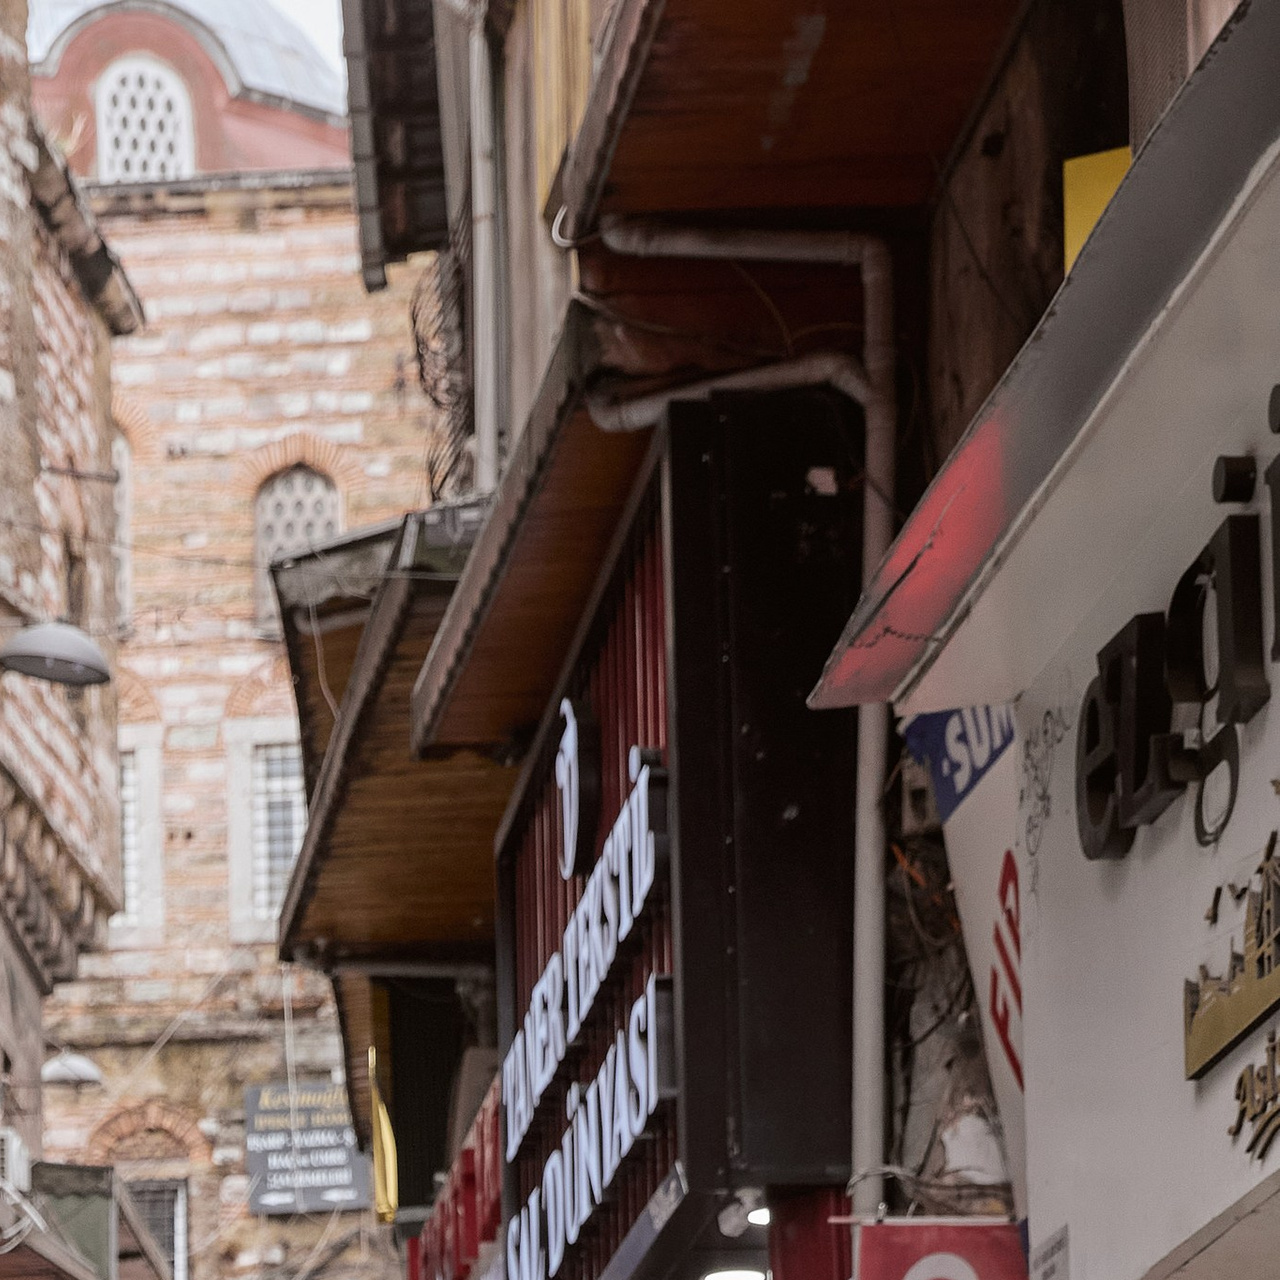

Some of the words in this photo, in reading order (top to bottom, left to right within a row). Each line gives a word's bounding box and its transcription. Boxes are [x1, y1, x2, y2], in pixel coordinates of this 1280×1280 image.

[502, 952, 565, 1163] TANER
[563, 745, 655, 1043] TEKSTİL
[542, 972, 658, 1278] DÜNYASI
